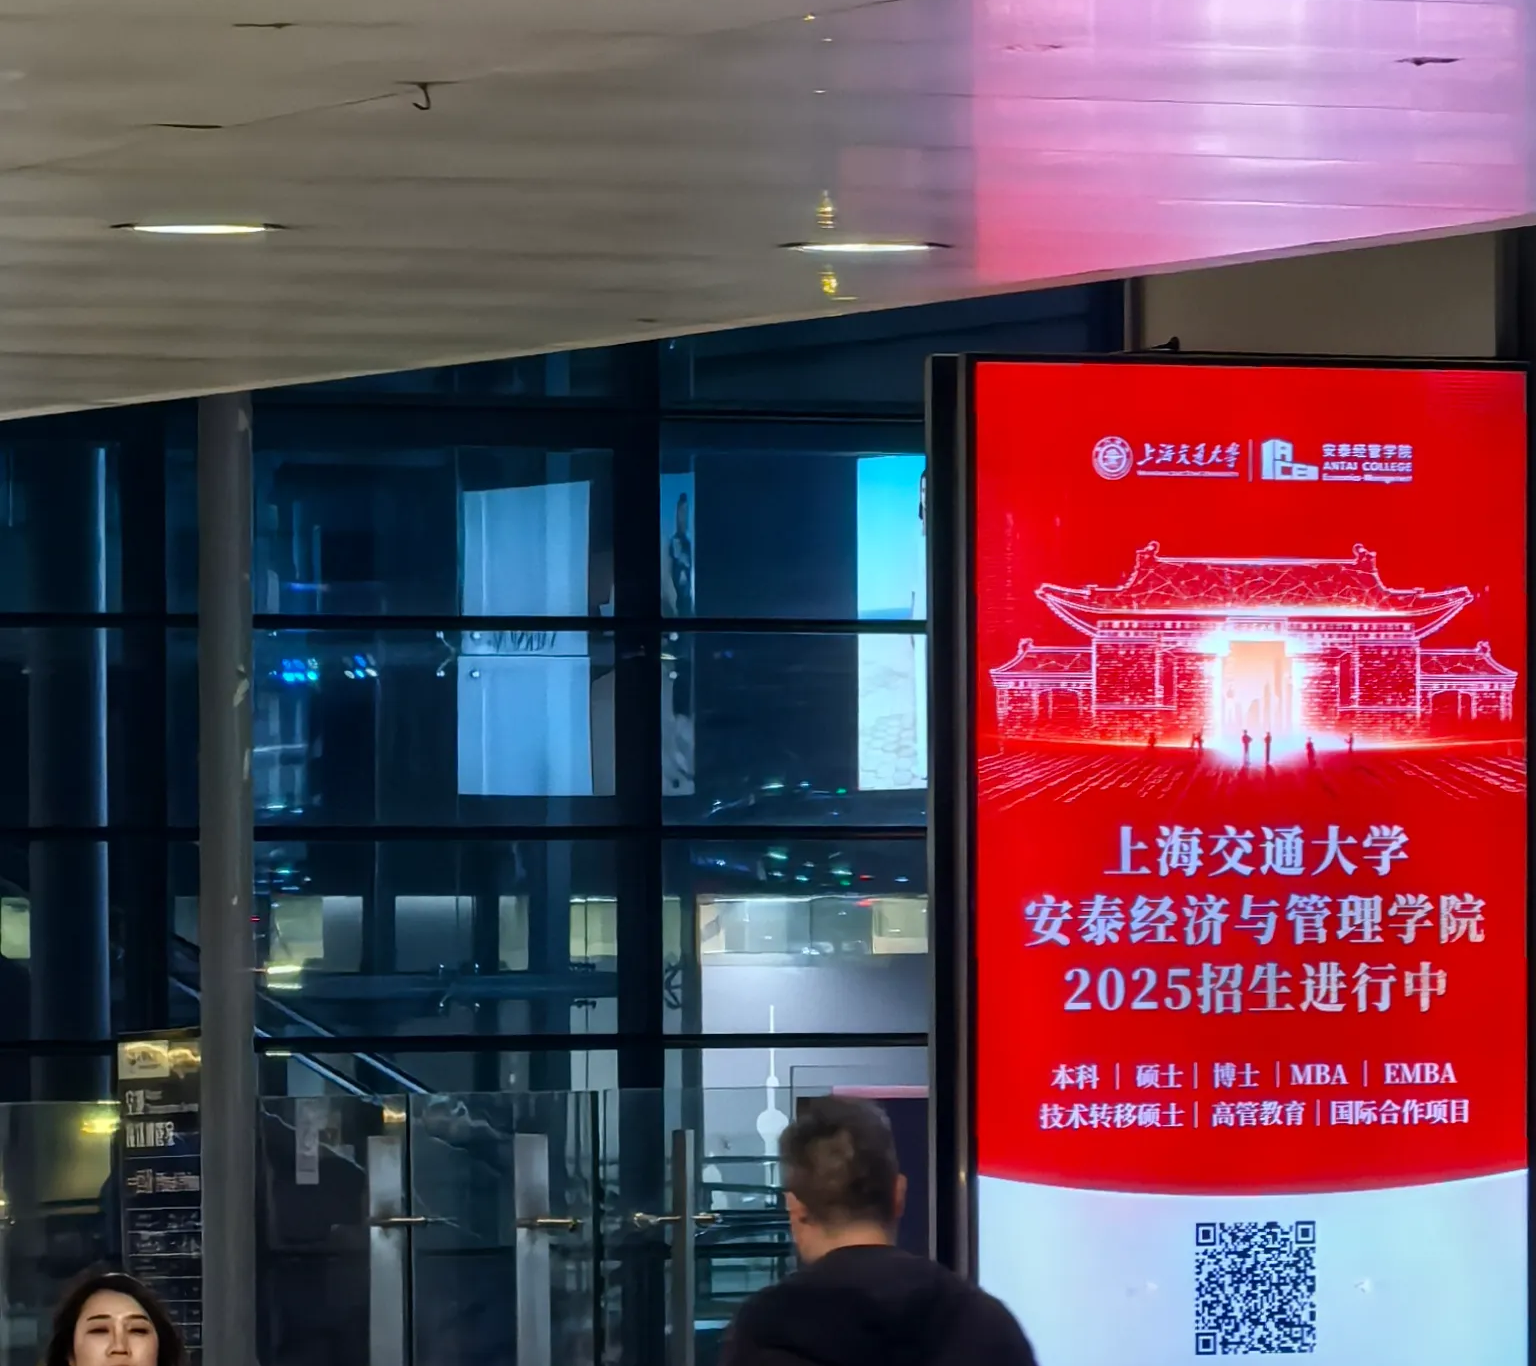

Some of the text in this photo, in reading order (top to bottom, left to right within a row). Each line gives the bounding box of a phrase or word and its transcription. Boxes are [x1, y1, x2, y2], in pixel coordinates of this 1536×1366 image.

[1322, 461, 1413, 472] ANTAI COLLEGE
[1104, 825, 1409, 877] 上海交通大学
[1024, 893, 1487, 947] 安泰经济与管理学院
[1063, 961, 1448, 1014] 2025招生进行中
[1051, 1062, 1458, 1090] 本科 硕士 博士 MBA EMBA
[1039, 1099, 1469, 1130] 技术转移硕士 高管教育 国际合作项目
